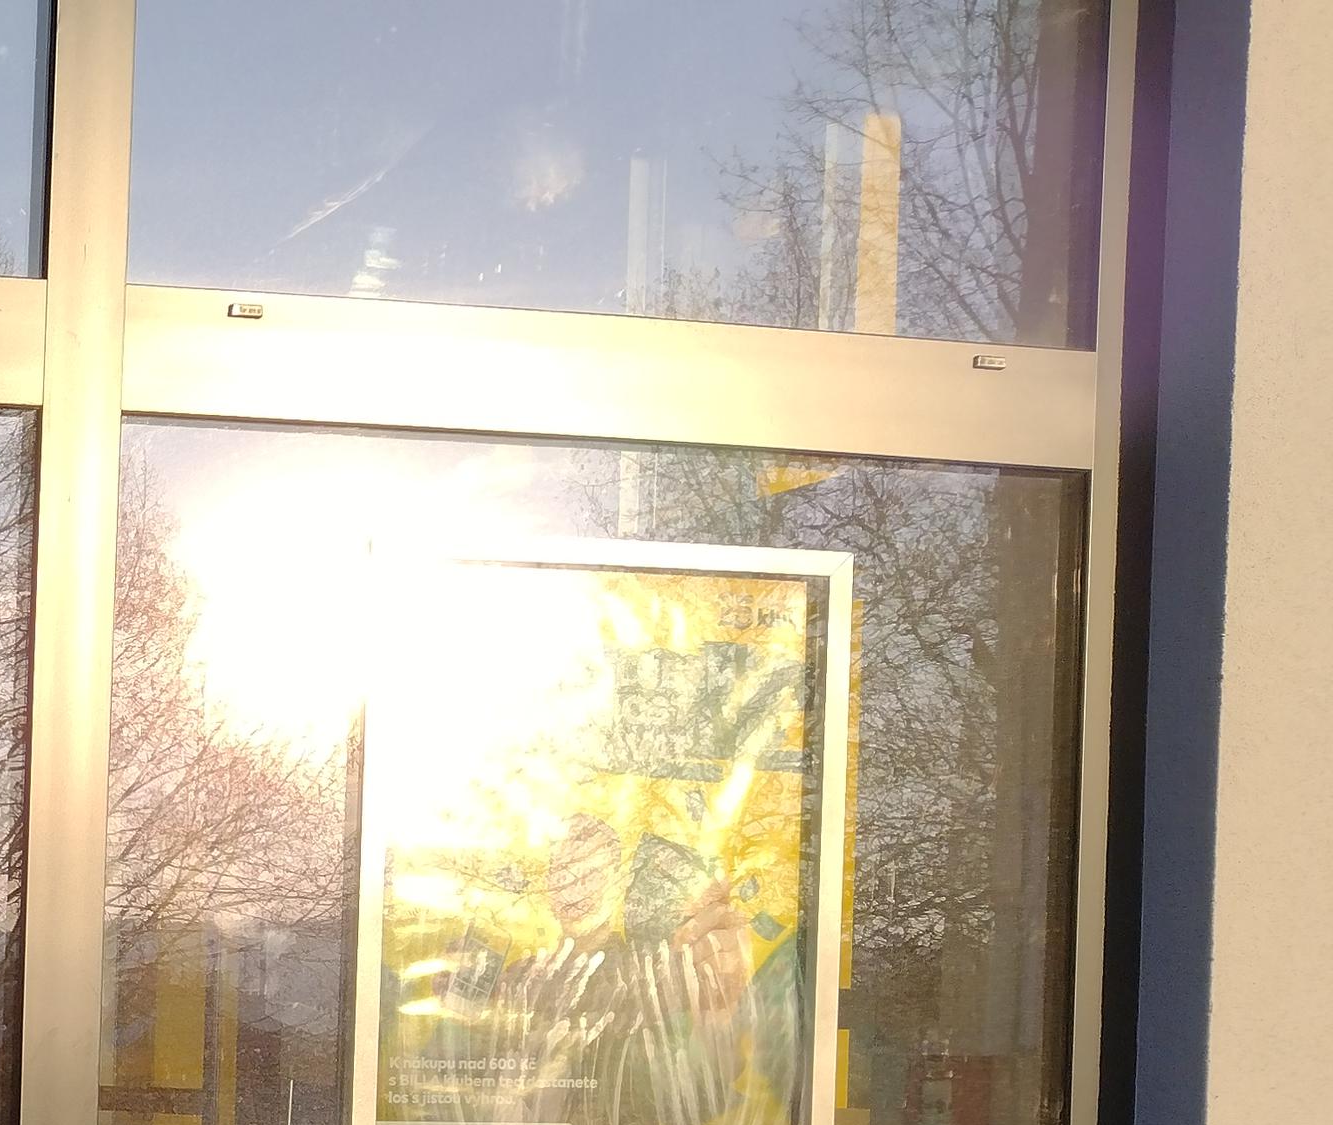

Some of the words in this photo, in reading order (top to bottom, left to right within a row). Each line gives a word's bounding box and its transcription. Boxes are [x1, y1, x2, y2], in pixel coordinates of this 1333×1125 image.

[389, 1057, 400, 1070] K
[403, 1056, 455, 1072] nákupu
[459, 1058, 486, 1070] nad
[489, 1058, 517, 1070] 600
[388, 1092, 408, 1104] los
[412, 1094, 419, 1104] s
[421, 1093, 461, 1107] jistou
